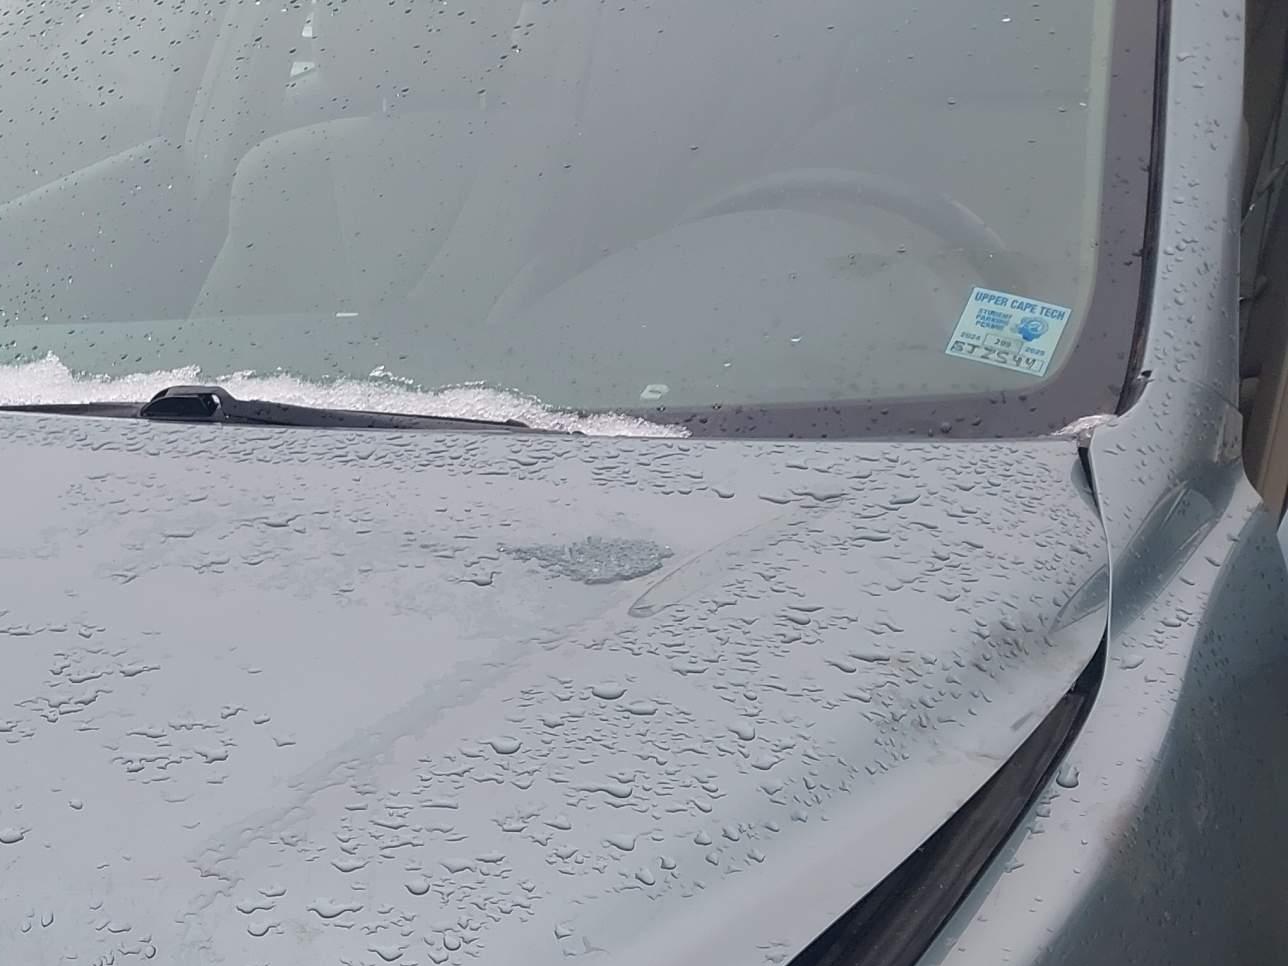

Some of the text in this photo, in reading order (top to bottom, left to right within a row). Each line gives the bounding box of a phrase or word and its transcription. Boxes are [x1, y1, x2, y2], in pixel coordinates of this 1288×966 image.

[974, 291, 1066, 321] UPPER CAPE TECH
